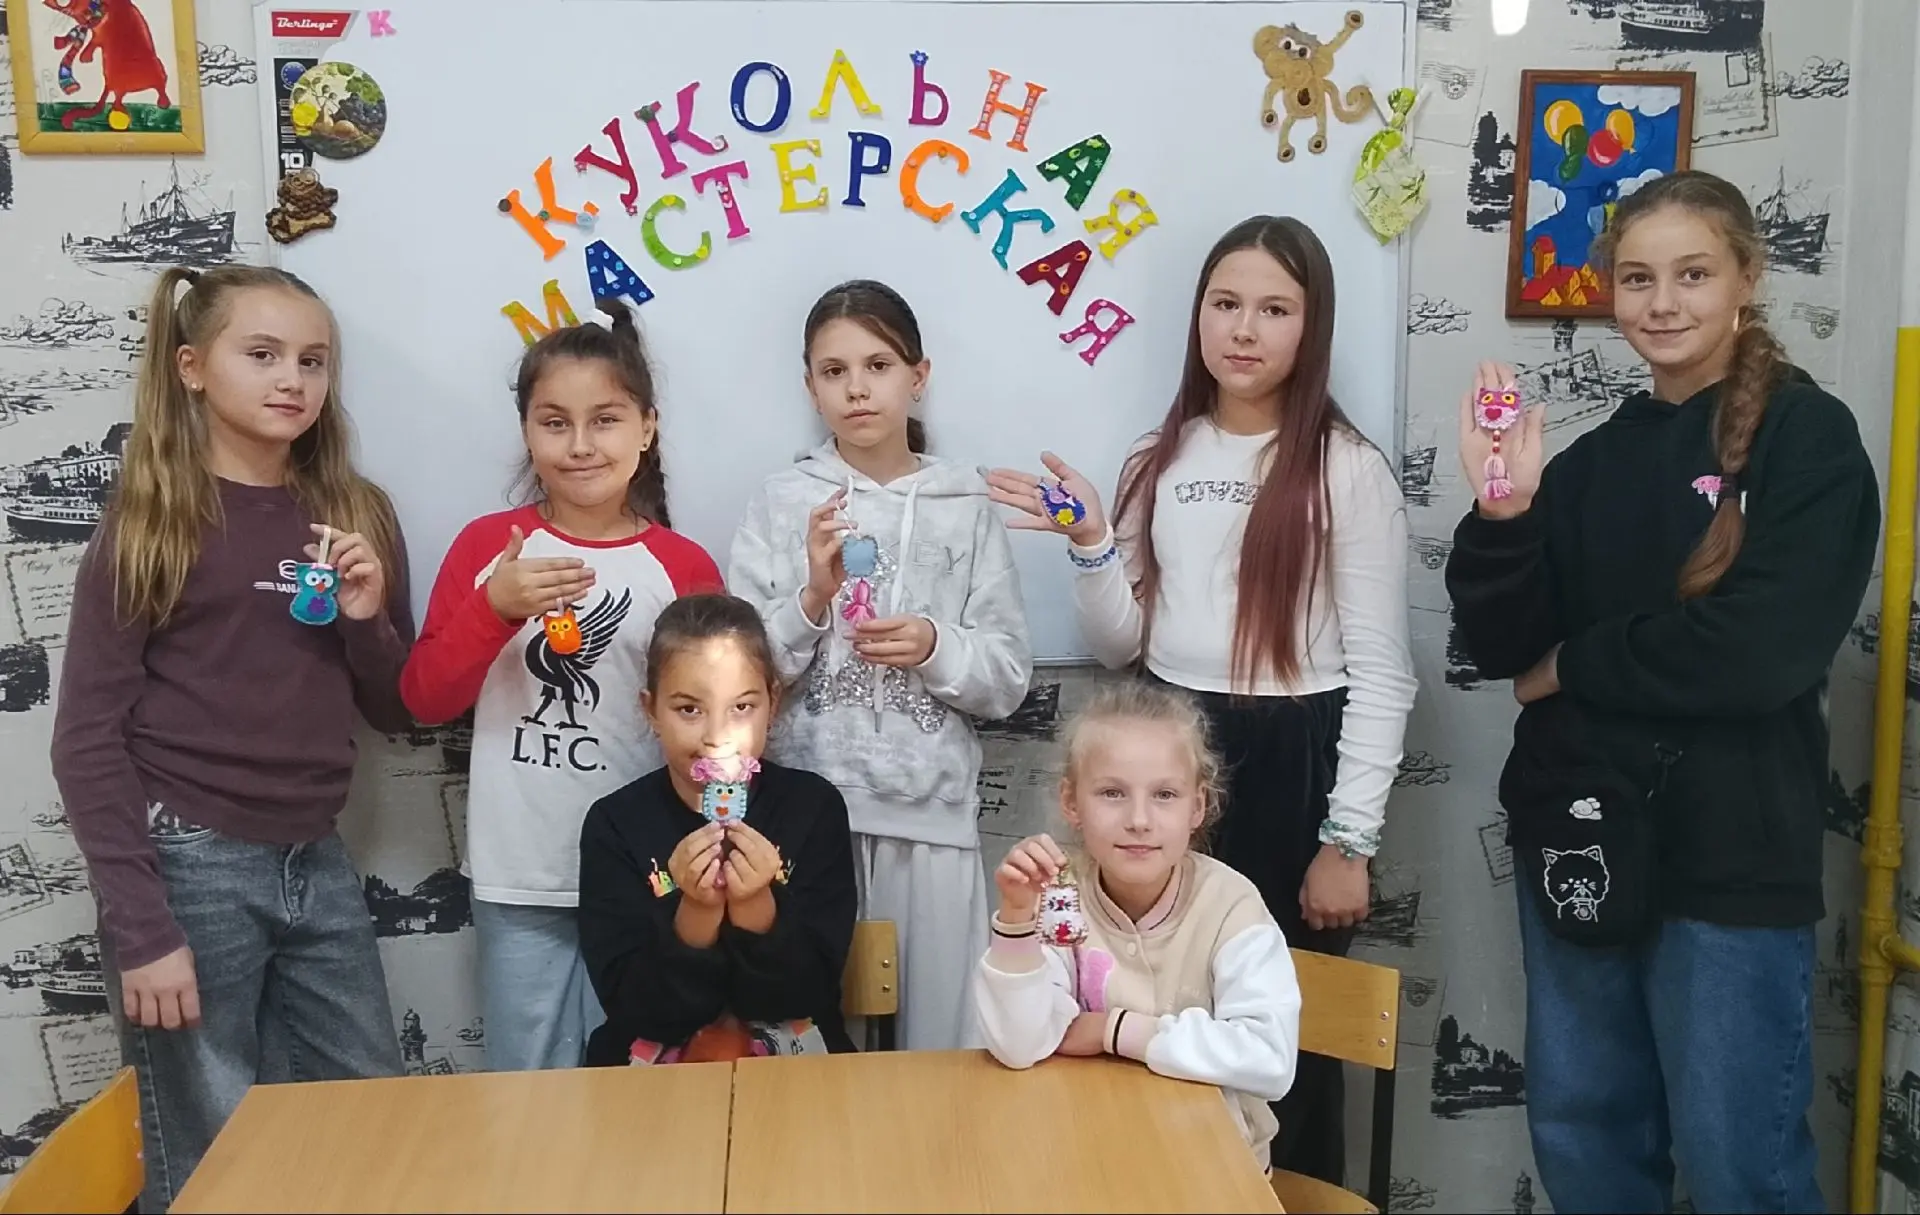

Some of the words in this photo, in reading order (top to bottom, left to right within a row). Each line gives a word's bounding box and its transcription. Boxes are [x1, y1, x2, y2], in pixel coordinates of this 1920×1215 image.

[275, 16, 334, 32] Berlingo
[280, 152, 305, 169] 10
[498, 48, 1160, 262] КУКОЛЬНАЯ
[500, 131, 1137, 367] МАСТЕРСКАЯ
[511, 726, 608, 772] L.F.C.
